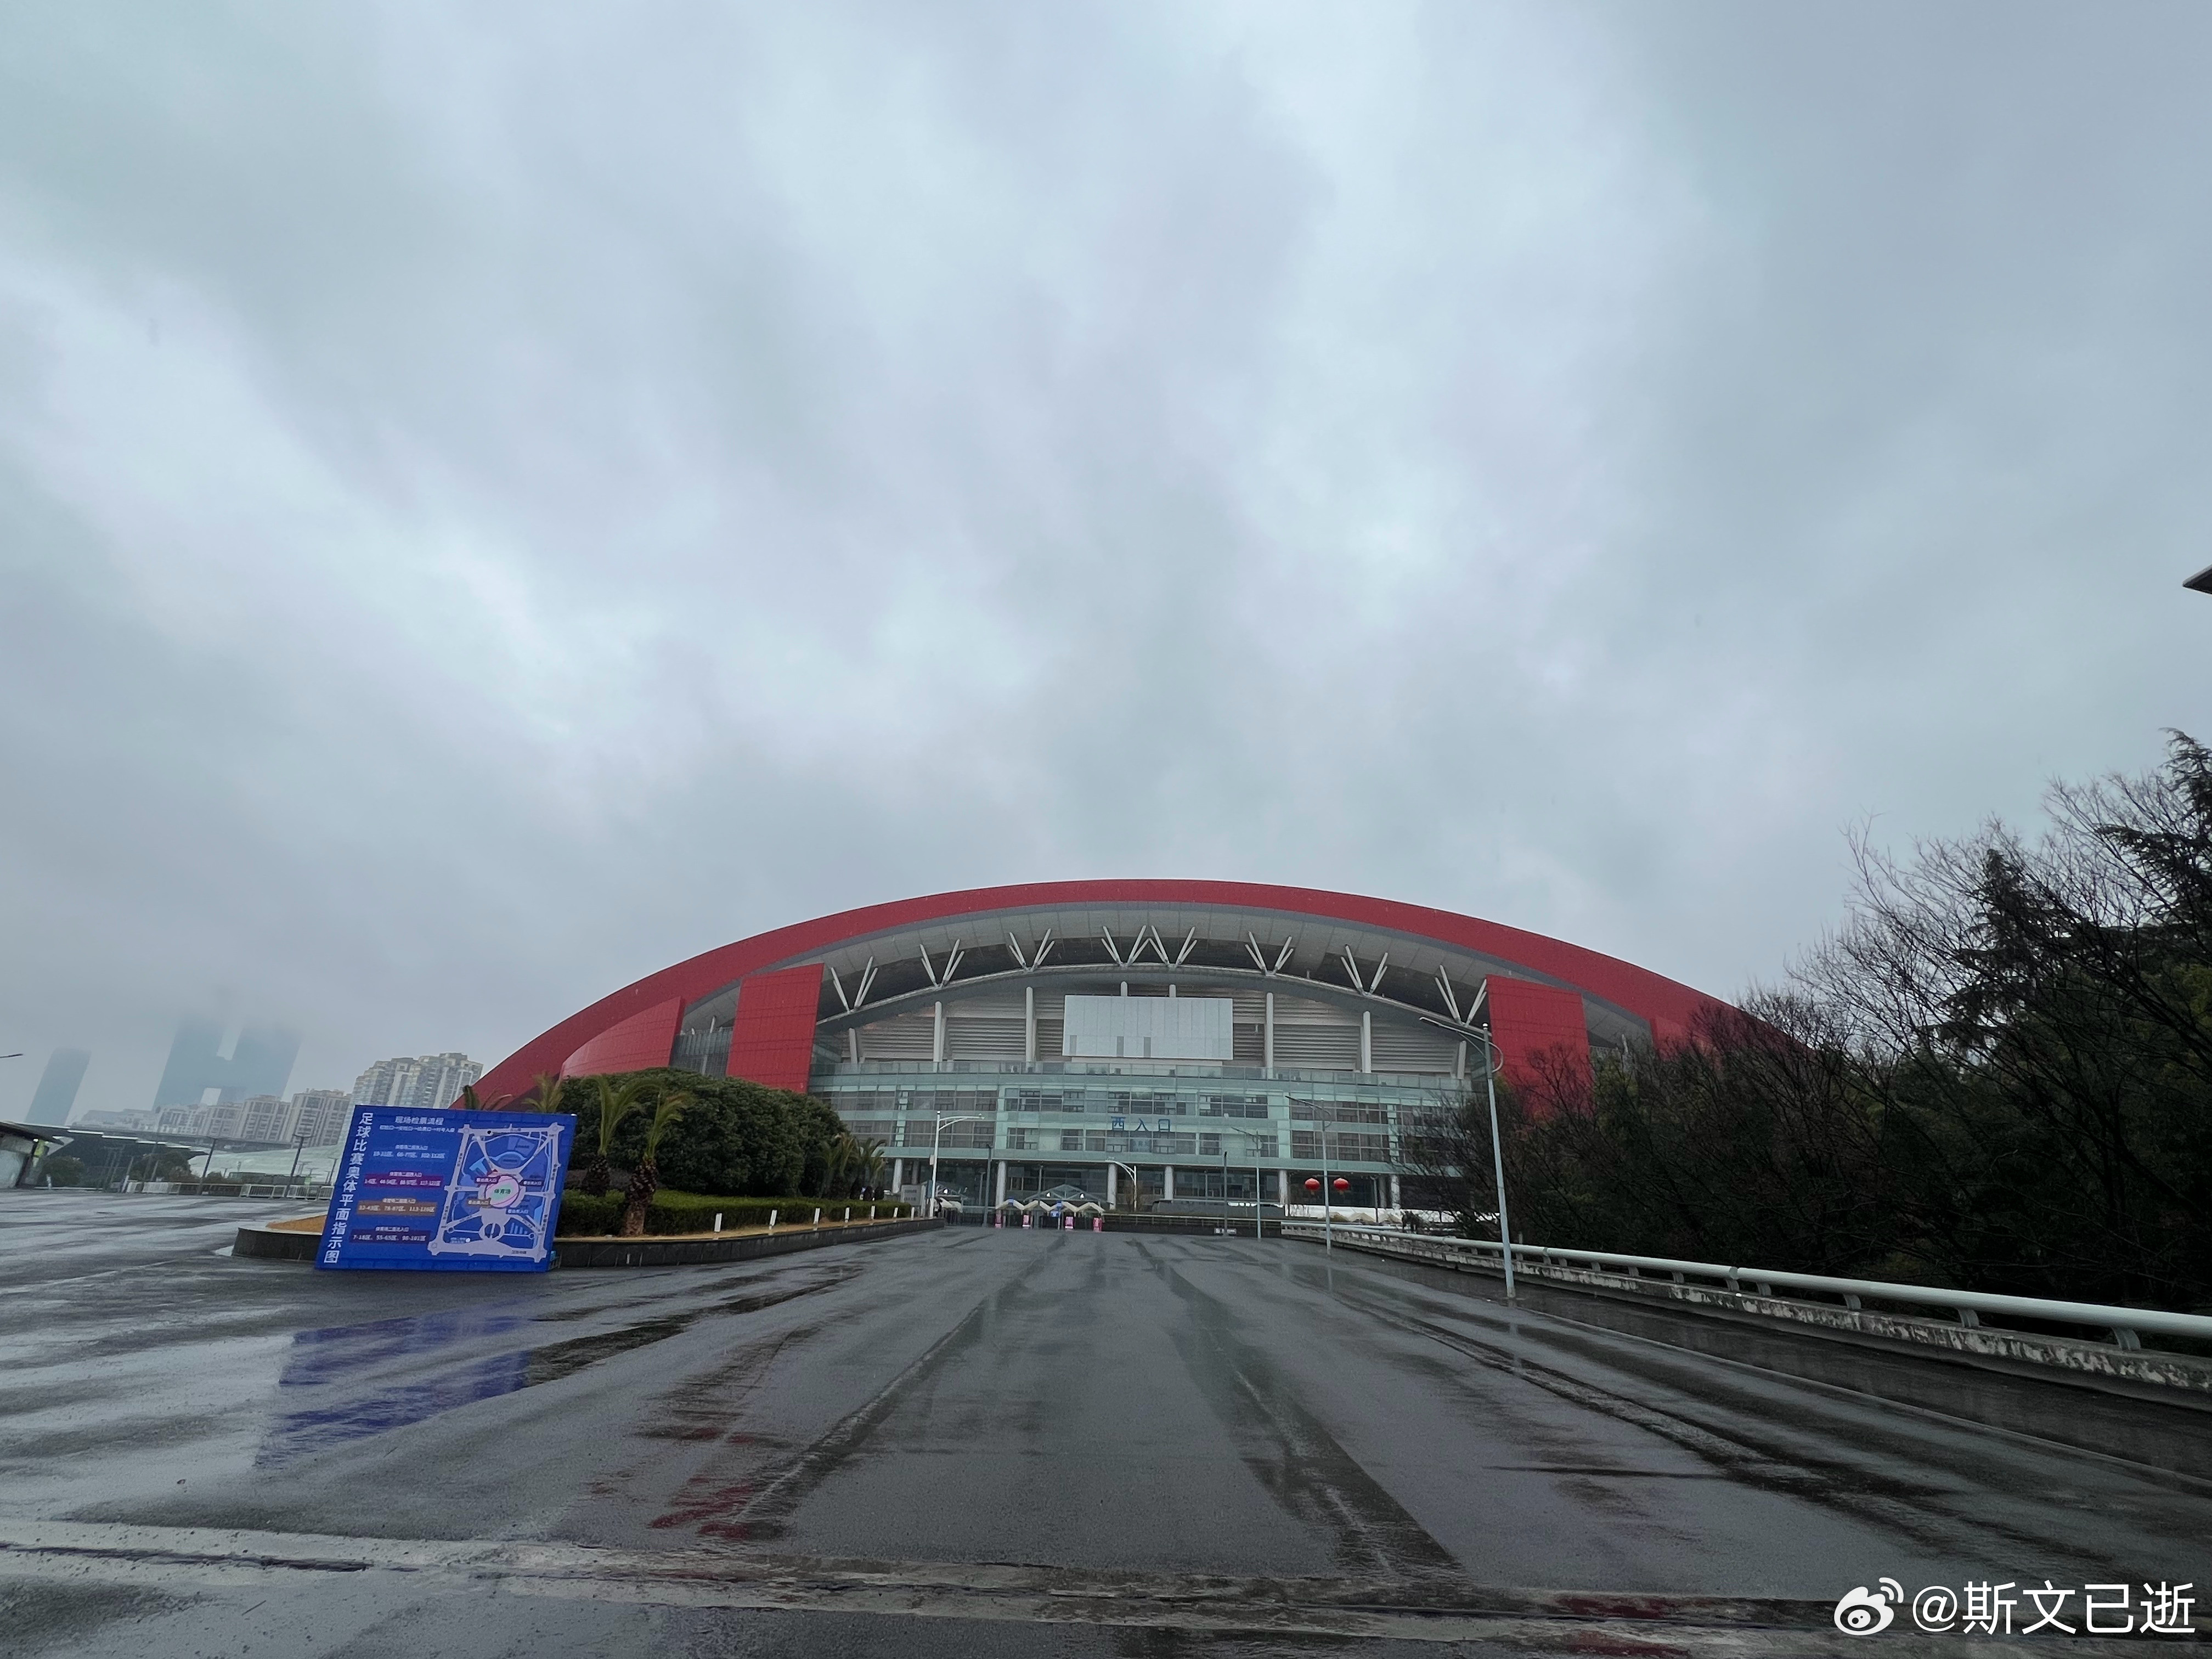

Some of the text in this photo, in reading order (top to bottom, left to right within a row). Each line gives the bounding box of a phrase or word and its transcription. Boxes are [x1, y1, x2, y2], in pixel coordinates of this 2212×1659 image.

[1111, 1116, 1170, 1132] 西入口
[324, 1113, 373, 1264] 足球比赛奥体平面指示图
